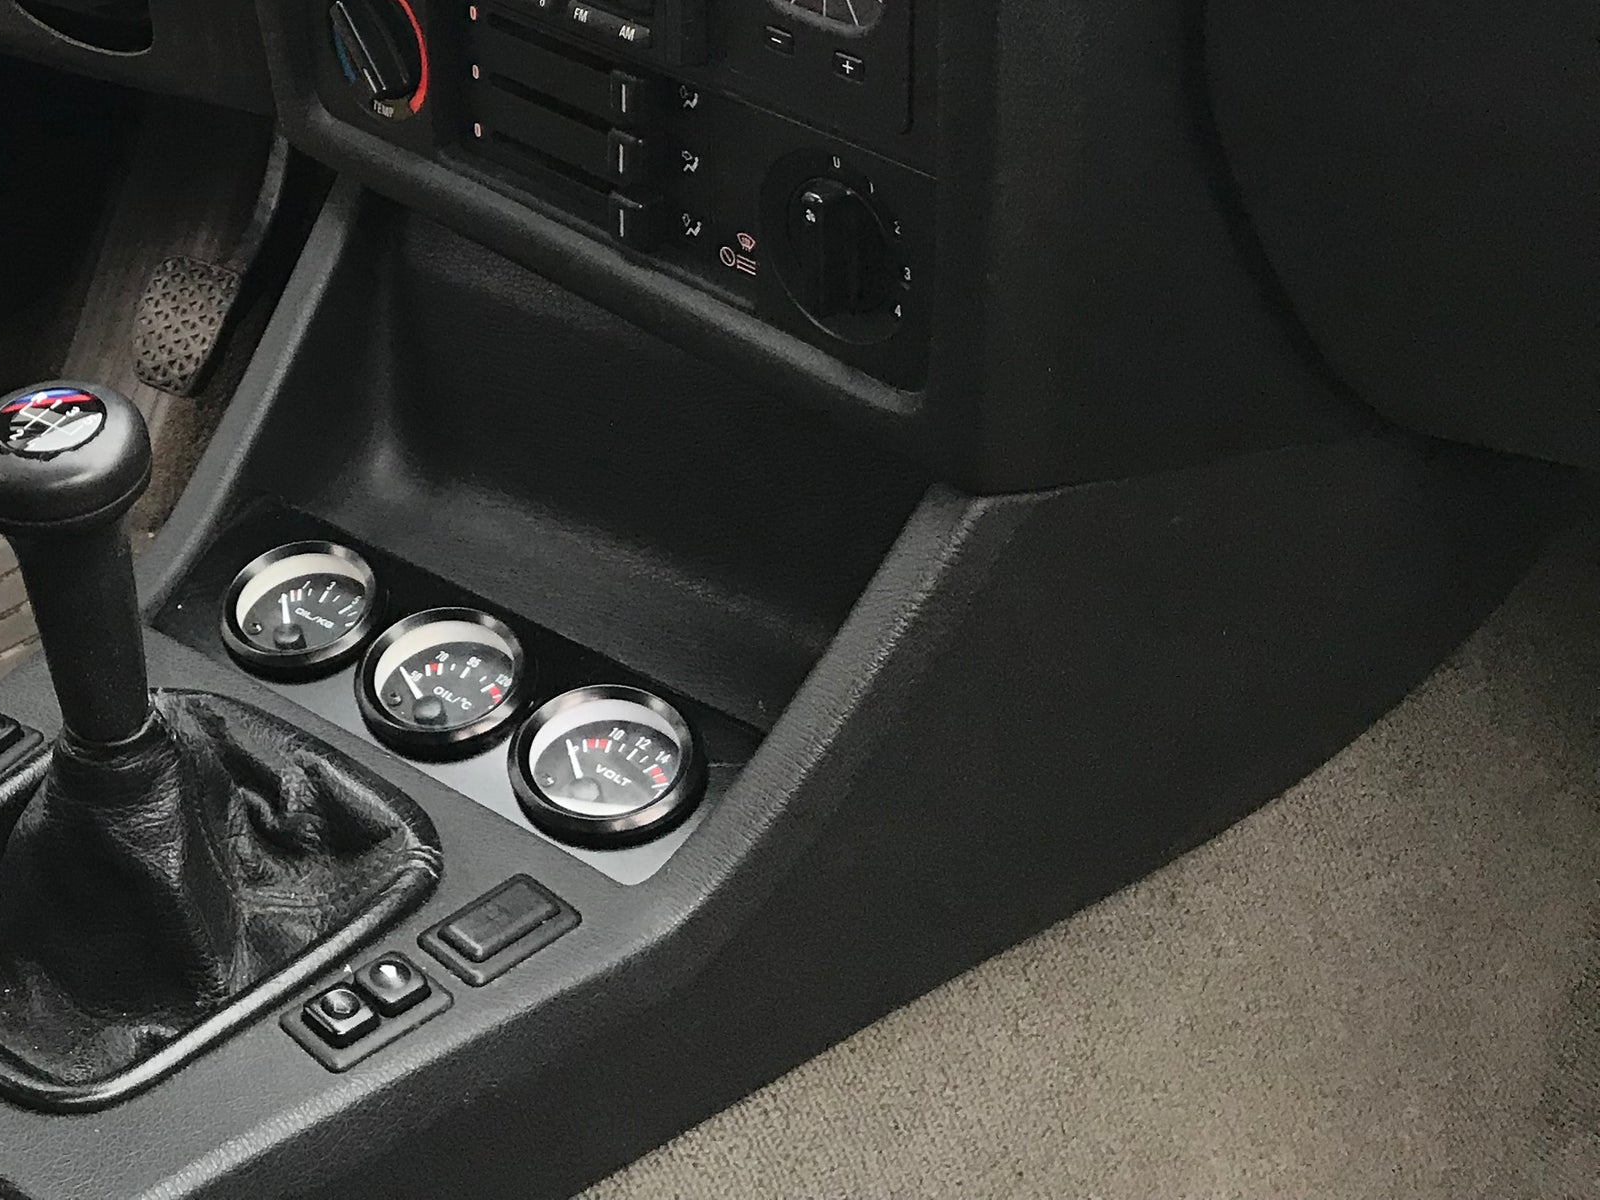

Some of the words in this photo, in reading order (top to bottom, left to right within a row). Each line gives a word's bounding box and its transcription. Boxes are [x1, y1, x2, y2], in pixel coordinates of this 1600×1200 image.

[573, 7, 589, 22] FM
[618, 25, 636, 42] AM
[373, 100, 394, 118] TEMP
[904, 266, 912, 281] 3
[894, 304, 902, 317] 4
[66, 406, 80, 417] 3
[9, 429, 25, 440] 2
[326, 581, 337, 591] 3
[351, 595, 362, 605] 5
[435, 650, 450, 662] 70
[466, 656, 481, 668] 95
[410, 670, 423, 682] 50
[495, 673, 513, 688] 120
[608, 727, 626, 741] 10
[635, 736, 652, 750] 12
[655, 750, 671, 764] 14
[595, 763, 632, 786] VOLT
